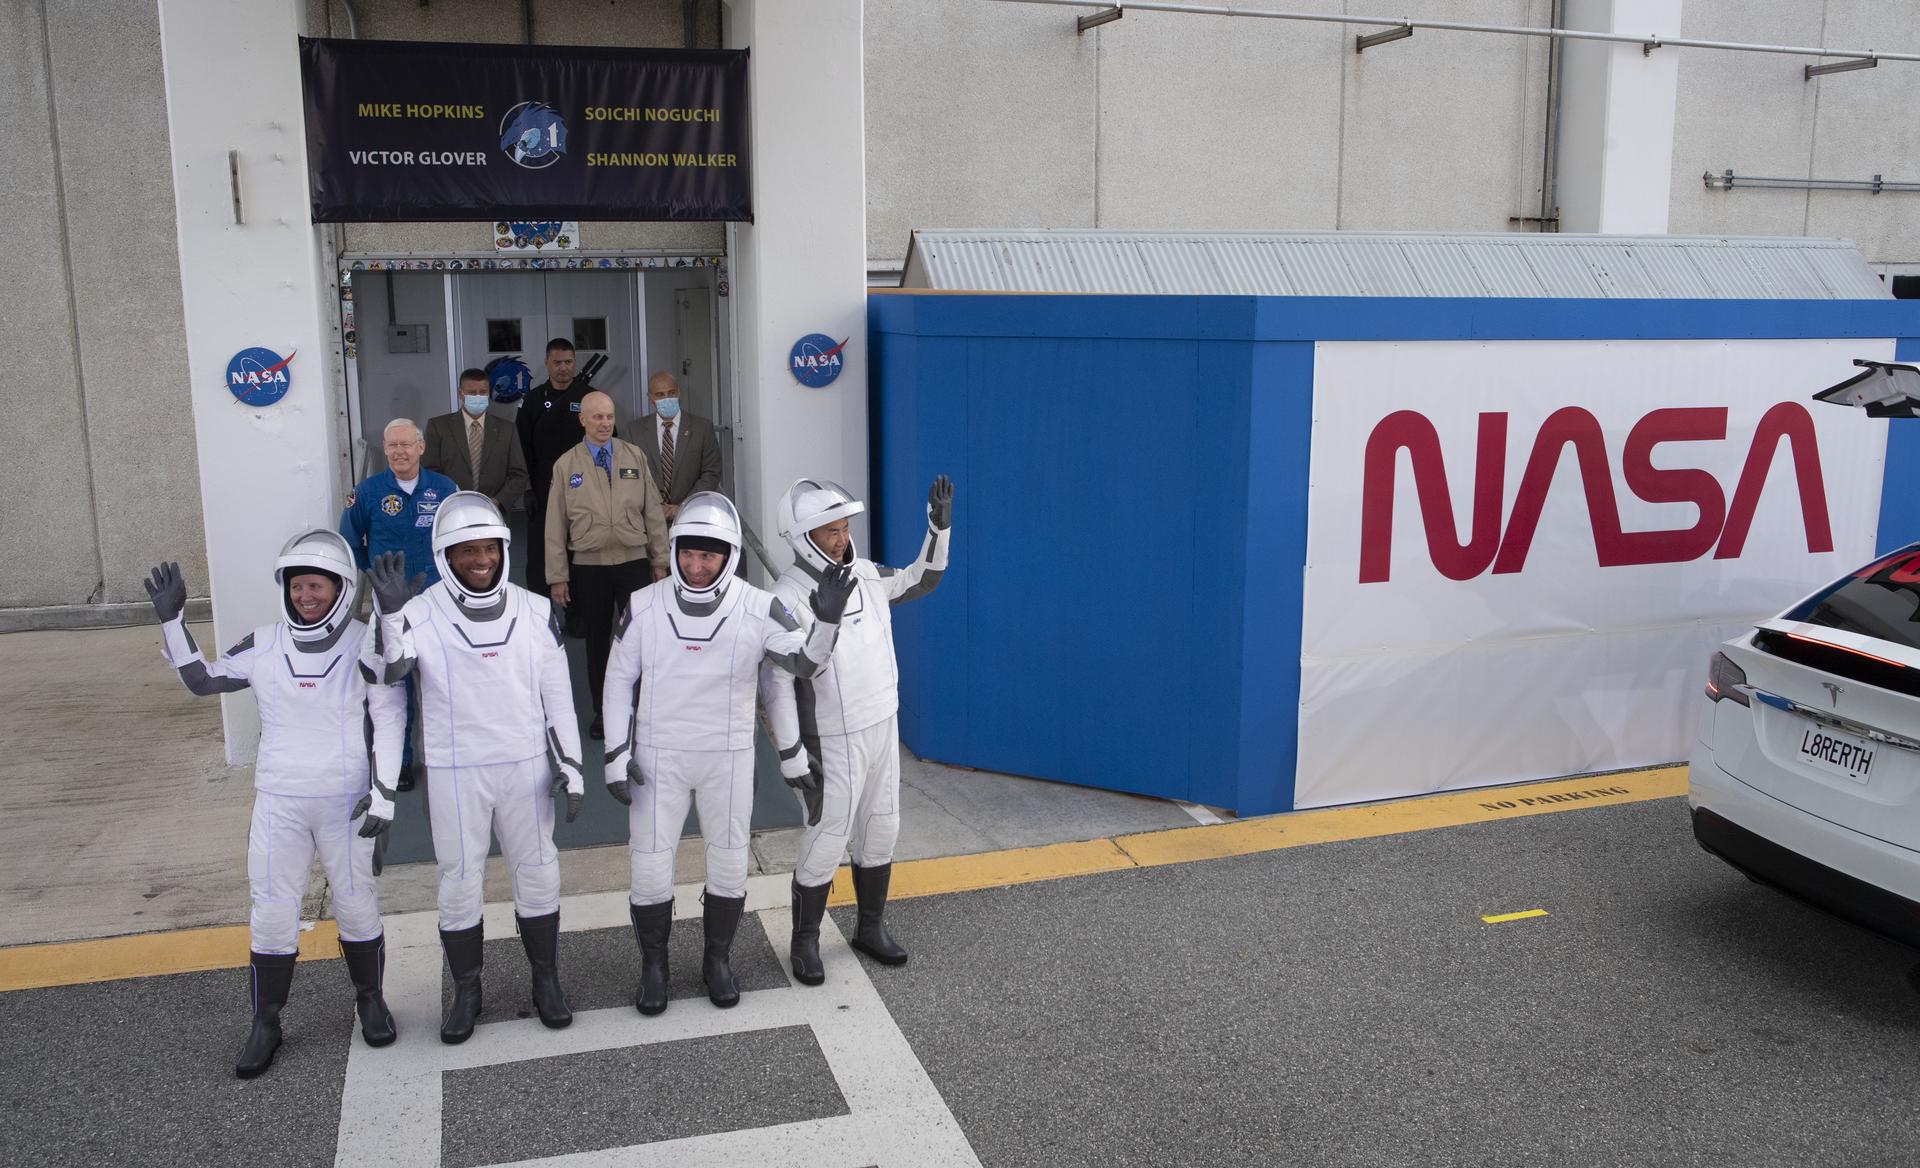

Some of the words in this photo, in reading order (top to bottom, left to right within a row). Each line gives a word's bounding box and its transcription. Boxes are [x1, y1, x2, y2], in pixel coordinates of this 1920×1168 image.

[358, 103, 402, 118] MIKE
[406, 104, 484, 119] HOPKINS
[584, 107, 641, 121] SOICHI
[645, 108, 720, 122] NOGUCHI
[349, 151, 415, 166] VICTOR
[418, 151, 487, 166] GLOVER
[586, 153, 669, 167] SHANNON
[672, 154, 737, 167] WALKER
[794, 354, 841, 368] NASA
[231, 370, 289, 385] NASA
[1359, 401, 1834, 583] NASA
[1801, 729, 1874, 775] L8RERTH
[1478, 800, 1517, 811] NO
[1518, 786, 1630, 806] PARKING
